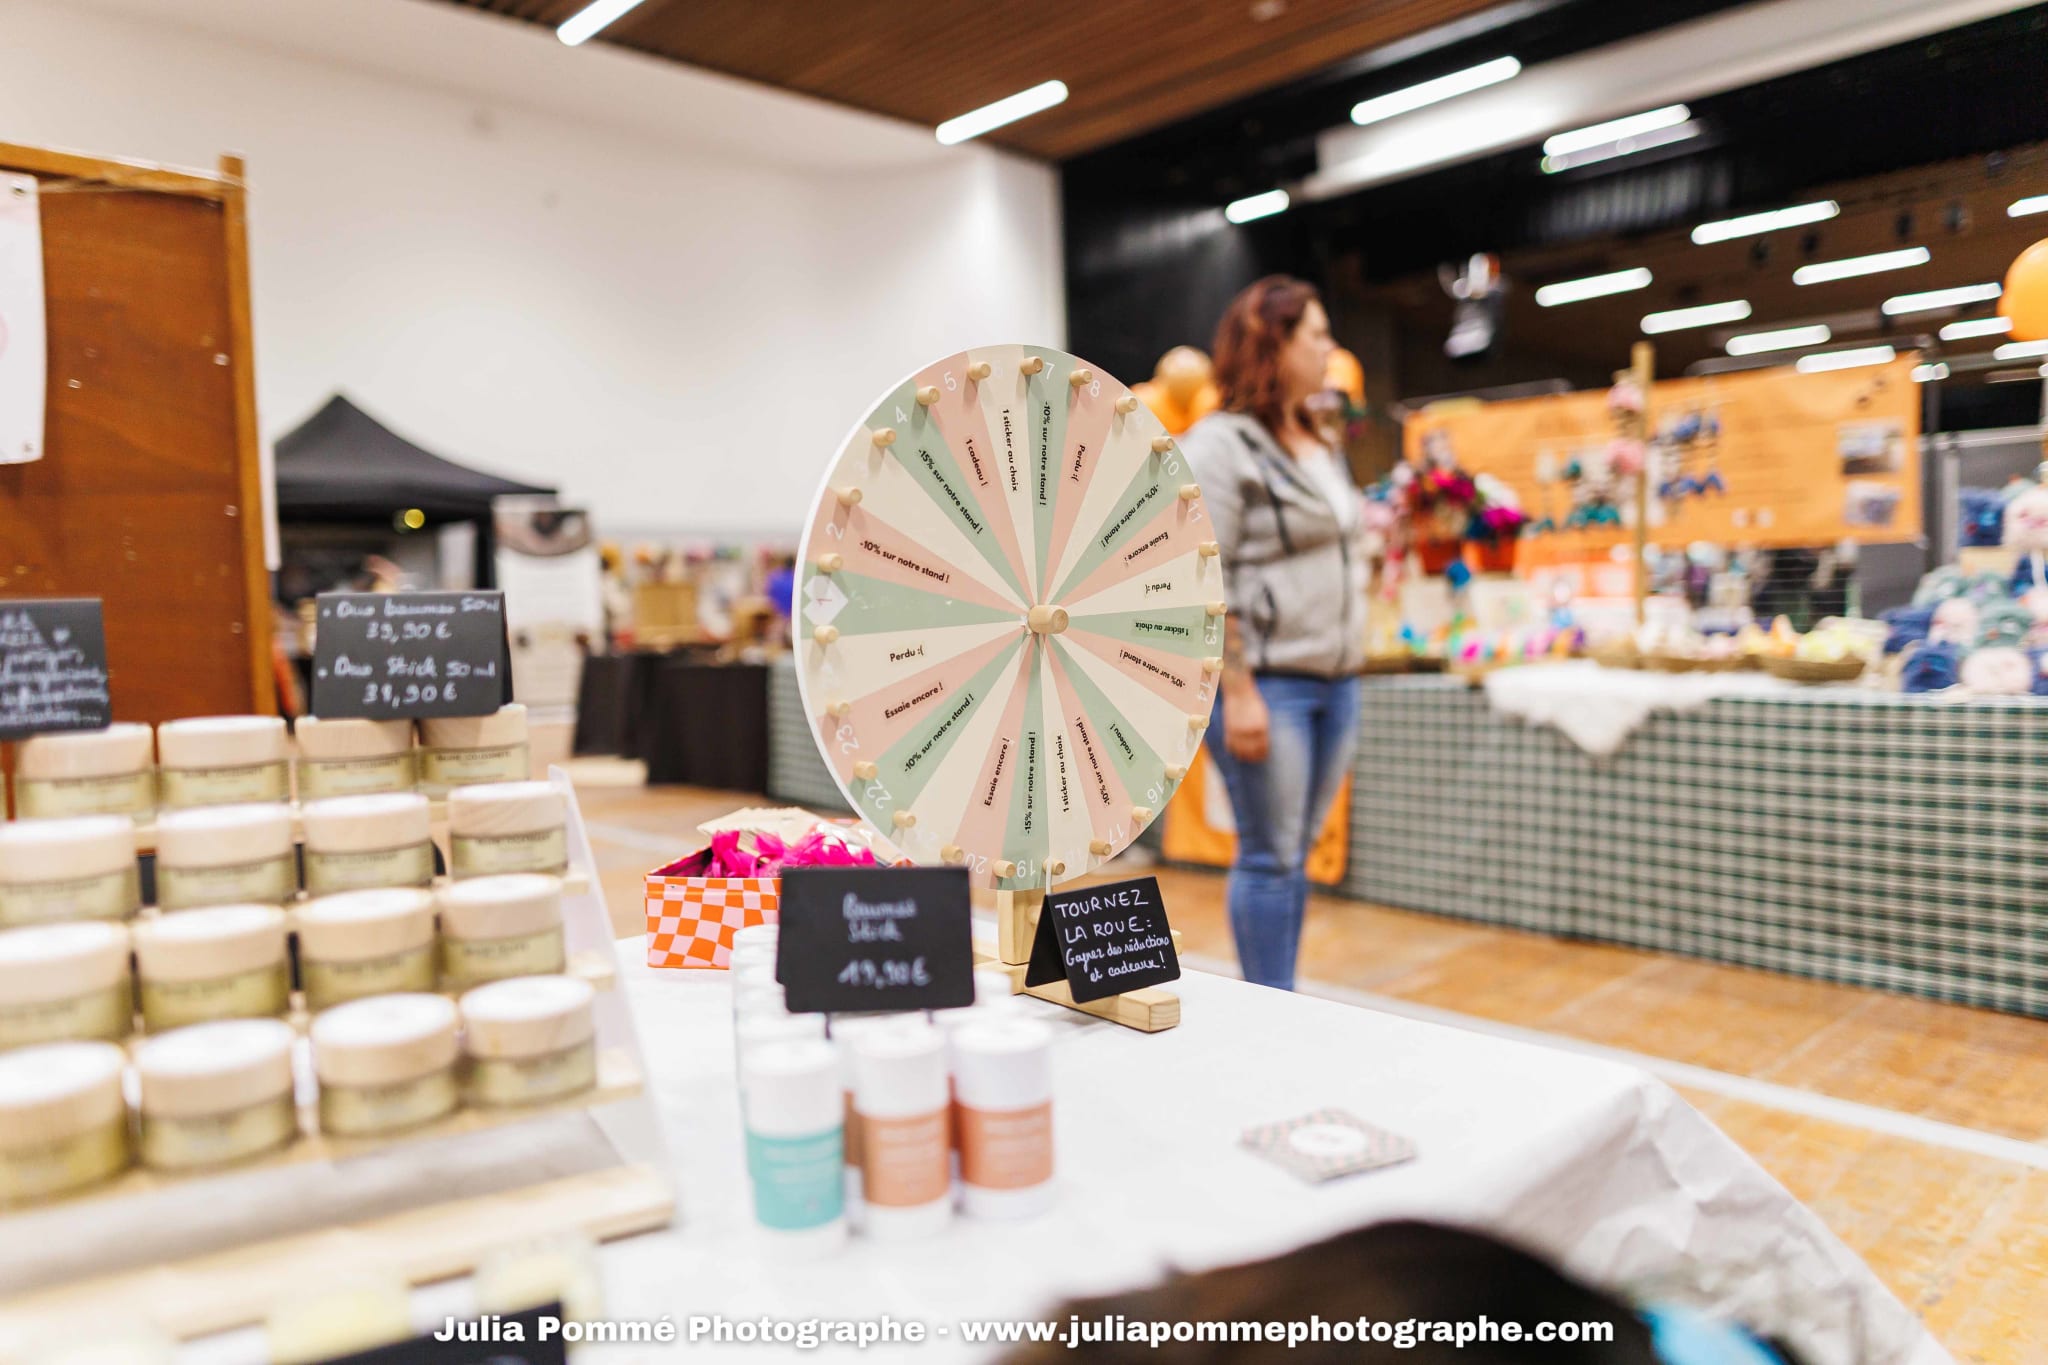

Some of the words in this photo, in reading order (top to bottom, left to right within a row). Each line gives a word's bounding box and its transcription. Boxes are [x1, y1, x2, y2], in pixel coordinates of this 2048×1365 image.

[944, 371, 957, 392] 5
[1046, 362, 1055, 380] 7
[1090, 380, 1100, 398] 8
[896, 405, 908, 424] 4
[1004, 416, 1012, 448] sticker
[1008, 450, 1014, 464] au
[968, 446, 984, 482] cadeau
[1074, 444, 1086, 472] Perdu
[1162, 452, 1180, 476] 10
[918, 449, 934, 470] -15%
[932, 470, 945, 484] sur
[944, 484, 960, 507] notre
[960, 506, 979, 530] stand
[1145, 484, 1159, 500] -10%
[1136, 498, 1146, 510] sur
[1120, 508, 1136, 526] notre
[825, 522, 844, 540] 2
[1104, 524, 1121, 543] stand
[1150, 532, 1169, 547] Essaie
[860, 540, 881, 555] -10%
[882, 551, 896, 560] sur
[898, 556, 920, 571] notre
[922, 566, 945, 582] stand
[1128, 544, 1149, 560] encore
[1151, 582, 1171, 592] Perdu
[1136, 622, 1152, 632] choix
[1160, 626, 1185, 636] sticker
[1204, 624, 1217, 645] 13
[890, 648, 916, 662] Perdu
[1124, 651, 1142, 666] stand
[1142, 661, 1160, 674] notre
[1160, 670, 1170, 679] sur
[1171, 675, 1186, 688] -10%
[884, 702, 910, 719] Essaie
[912, 687, 939, 705] encore
[836, 724, 859, 755] 23
[904, 752, 922, 772] -10%
[921, 740, 932, 754] sur
[932, 720, 952, 742] notre
[951, 698, 971, 722] stand
[1076, 722, 1090, 746] stand
[1114, 726, 1132, 756] cadeau
[1056, 735, 1064, 760] choix
[1088, 746, 1098, 770] notre
[984, 776, 998, 807] Essaie
[994, 742, 1008, 776] encore
[1060, 762, 1066, 774] au
[1096, 770, 1104, 785] sur
[866, 778, 892, 808] 22
[1024, 811, 1032, 834] -15%
[1028, 736, 1036, 764] stand
[1060, 776, 1070, 806] sticker
[1100, 784, 1110, 806] -10%
[1147, 781, 1164, 804] 16
[965, 853, 987, 874] 20
[1016, 860, 1036, 878] 19
[1055, 889, 1148, 918] TOURNEZ
[1065, 926, 1088, 944] LA
[1066, 948, 1105, 973] Gagnez
[1107, 942, 1122, 956] des
[1090, 968, 1103, 982] et
